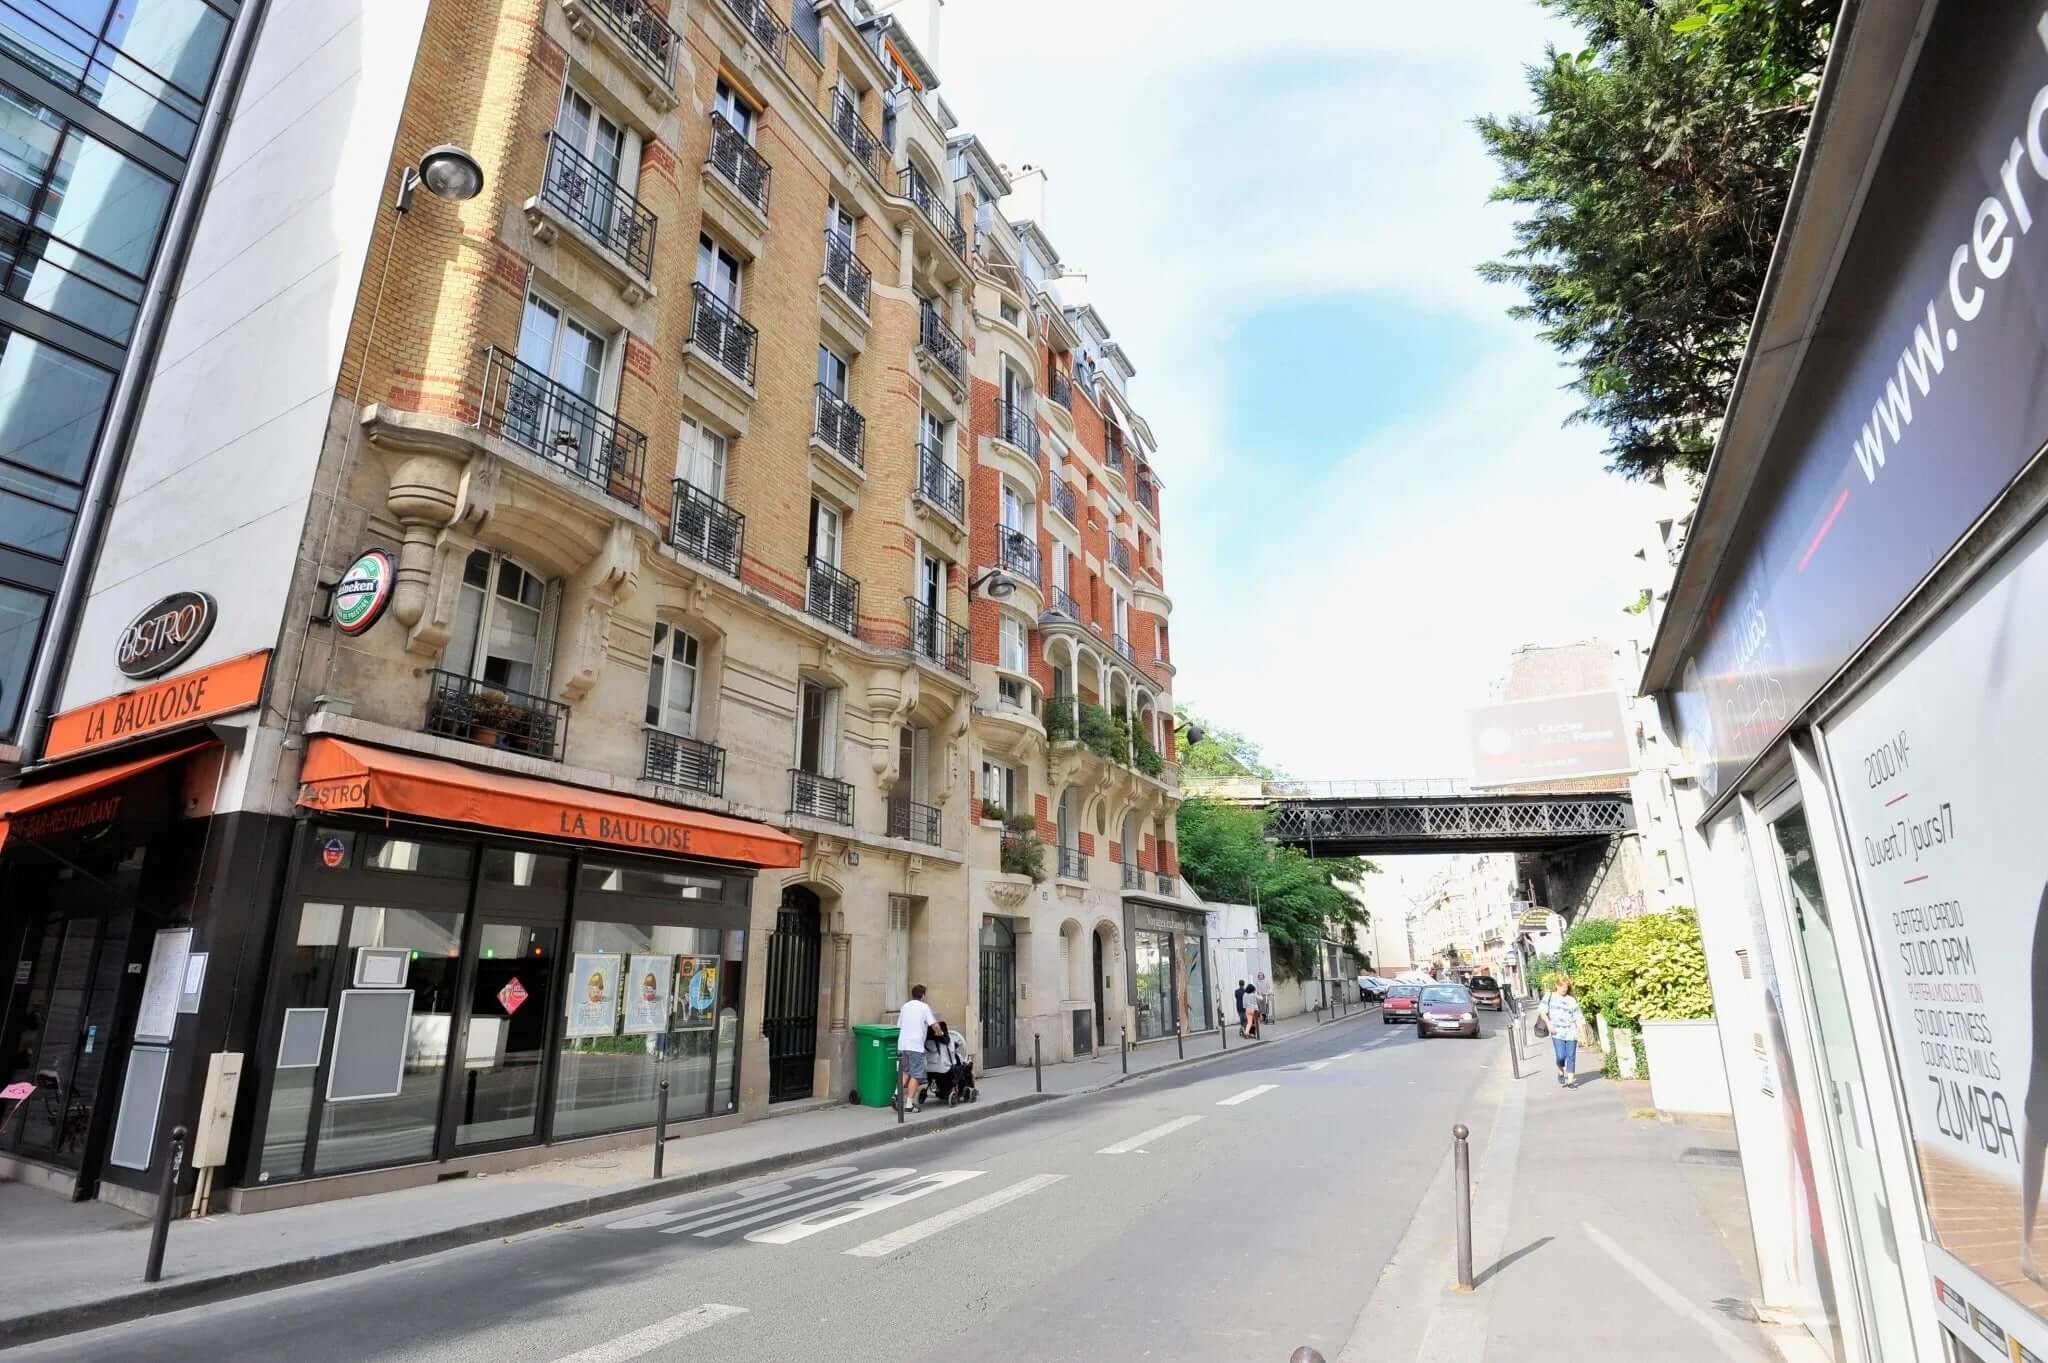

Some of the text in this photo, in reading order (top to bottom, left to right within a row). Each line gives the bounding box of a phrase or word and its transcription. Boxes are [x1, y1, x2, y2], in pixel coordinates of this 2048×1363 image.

[121, 604, 196, 663] BISTRO
[85, 675, 209, 743] LA BAULOISE
[1864, 743, 1895, 789] 2000
[560, 809, 691, 850] LA BAULOISE
[1864, 823, 1902, 867] Ouvert
[1897, 820, 1907, 856] 7
[1927, 900, 1965, 931] CARDIO
[1900, 935, 1977, 976] STUDIO RPM
[1914, 1008, 1993, 1044] STUDIO FITNESS
[1920, 1040, 2001, 1081] COURS LES MILLS
[1928, 1075, 2020, 1164] ZUMBA
